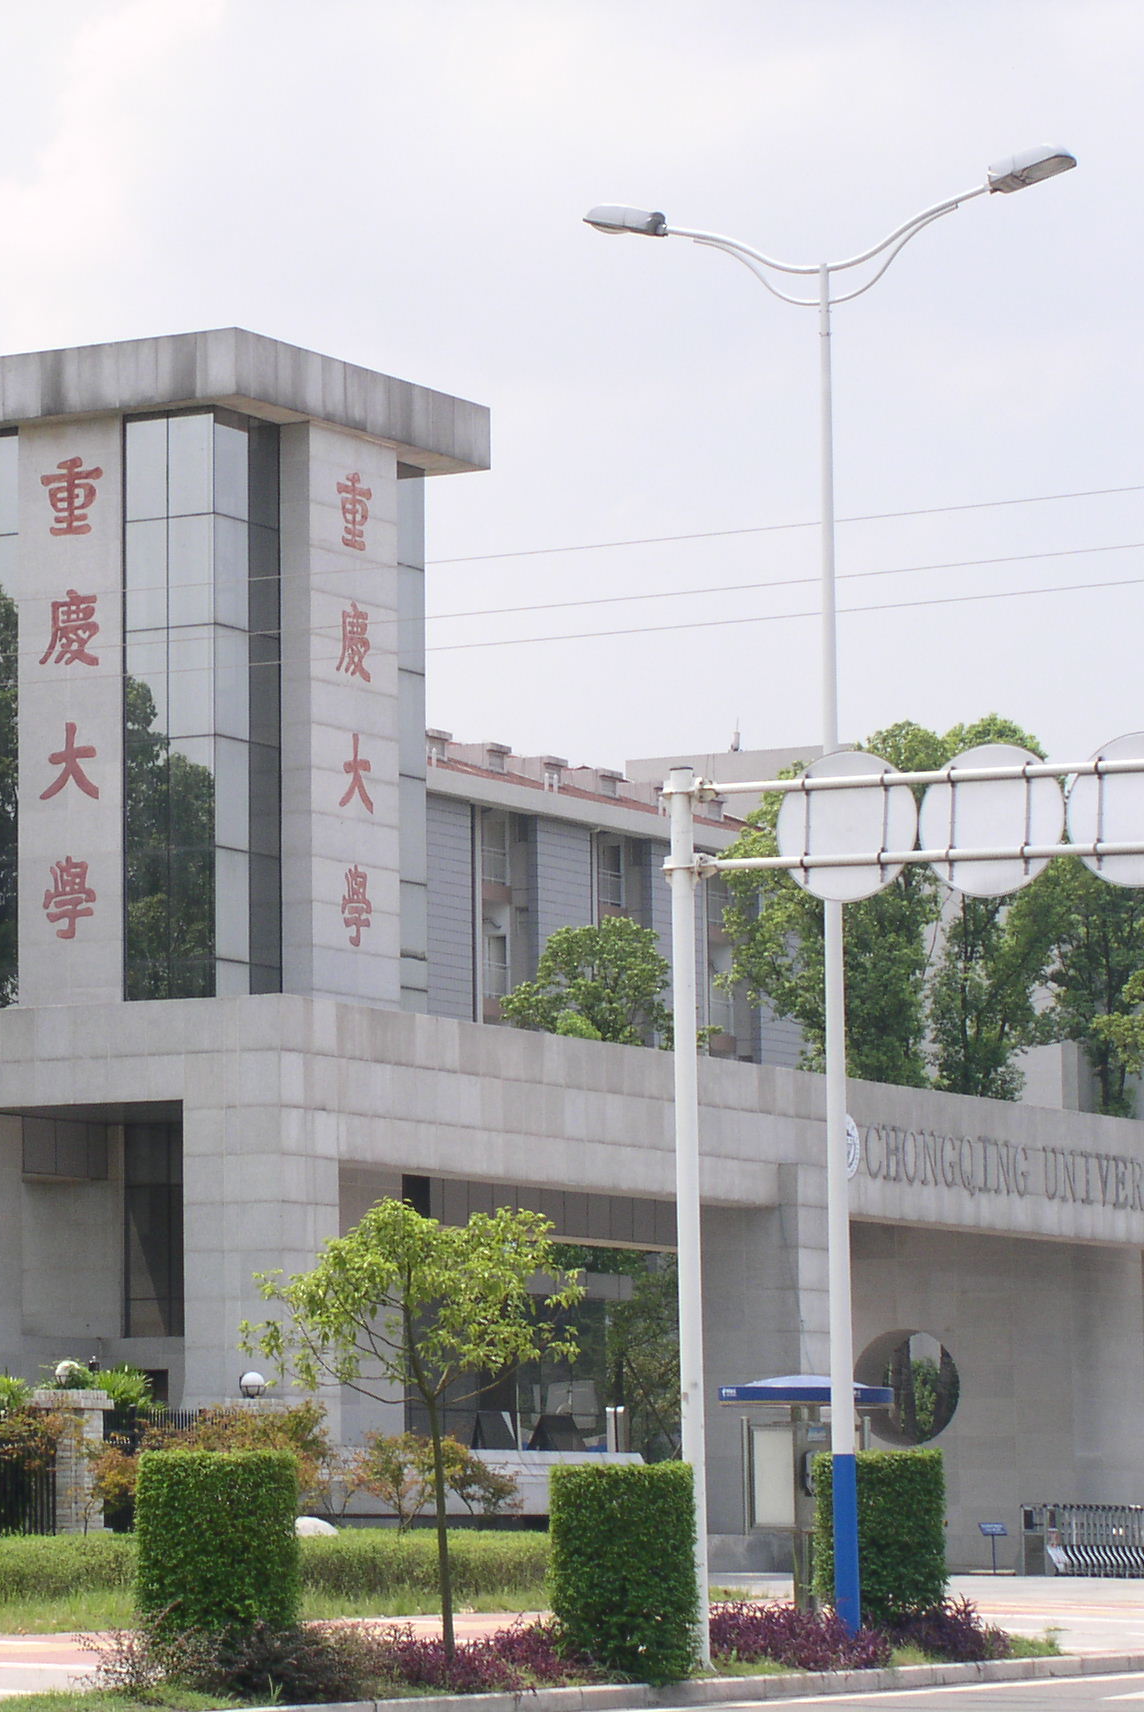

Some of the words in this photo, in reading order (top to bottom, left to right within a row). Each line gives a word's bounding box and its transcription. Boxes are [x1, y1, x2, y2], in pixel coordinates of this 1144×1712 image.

[40, 456, 104, 940] 重慶大學
[336, 472, 374, 948] 重慶大學
[864, 1122, 1029, 1197] CHONGQING
